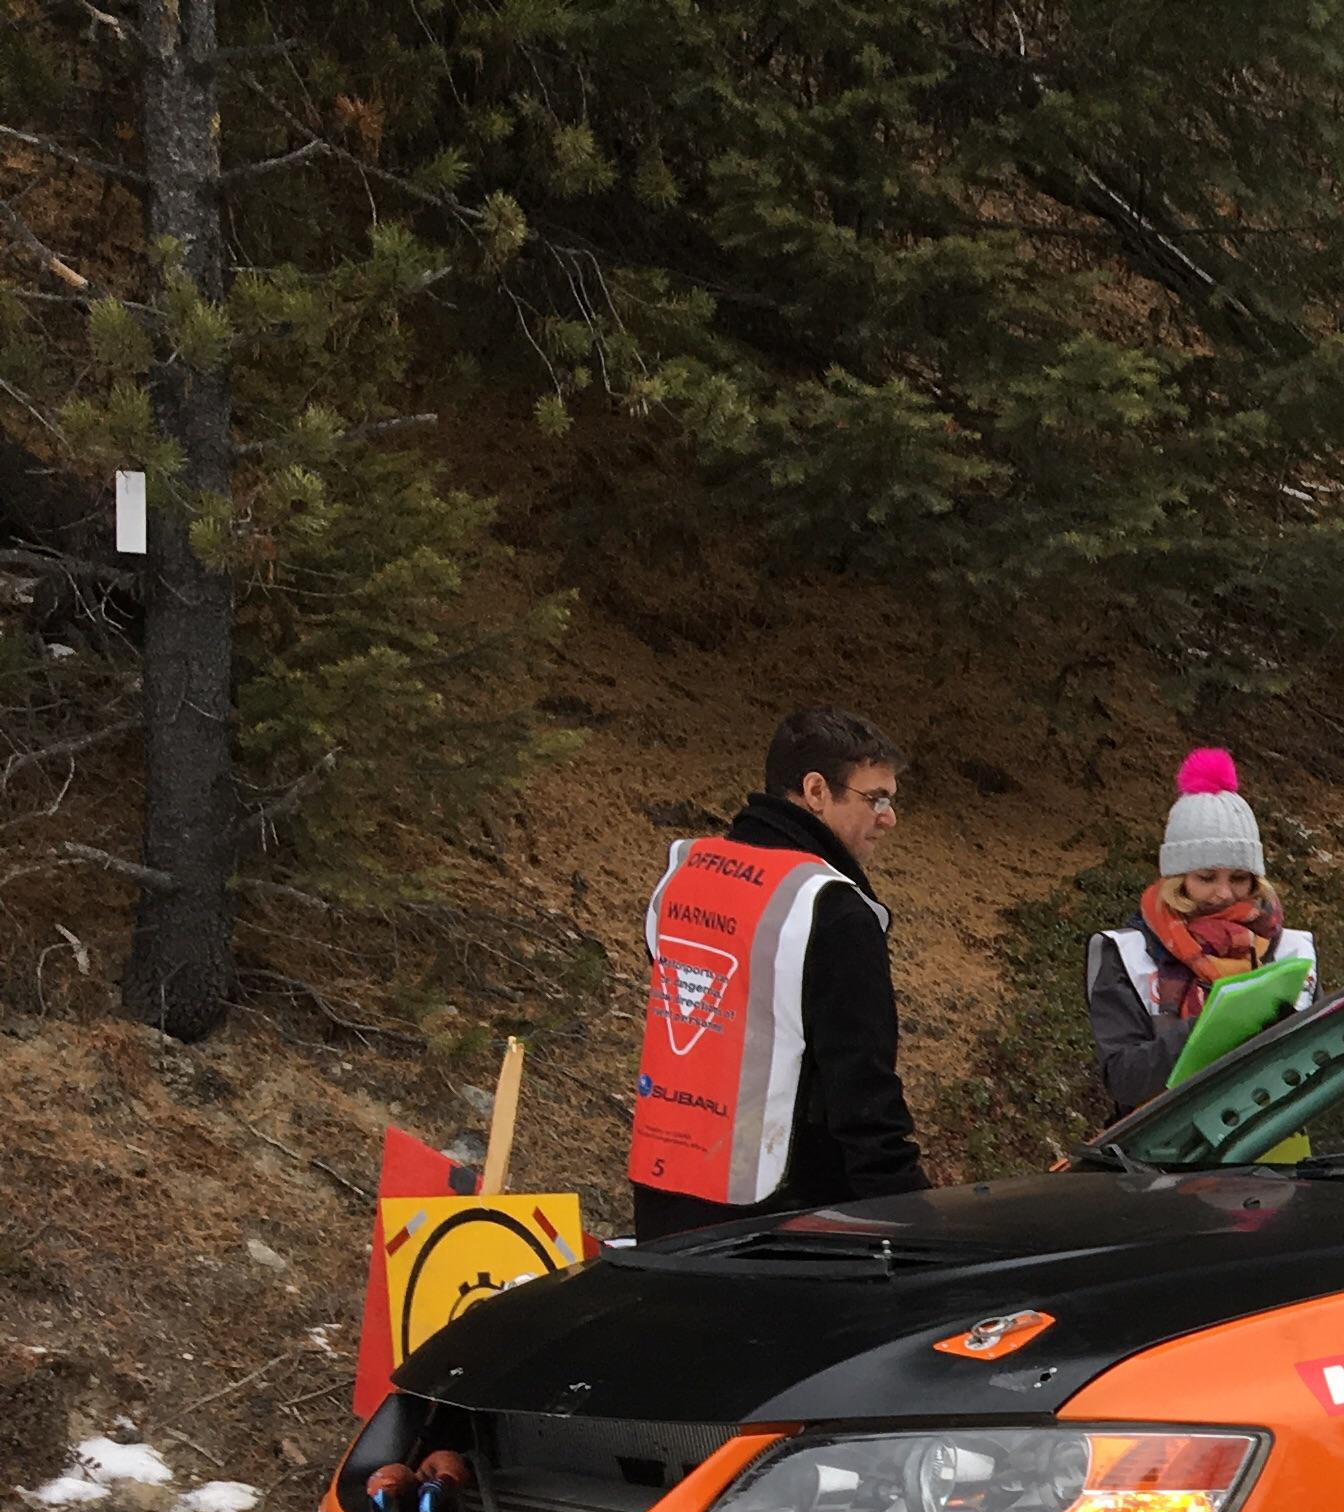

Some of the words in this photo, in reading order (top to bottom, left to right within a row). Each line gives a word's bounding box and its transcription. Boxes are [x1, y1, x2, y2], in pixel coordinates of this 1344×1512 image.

[687, 852, 766, 887] OFFICIAL
[667, 901, 738, 935] WARNING
[651, 1084, 728, 1117] SUBARU
[651, 1158, 665, 1176] 5
